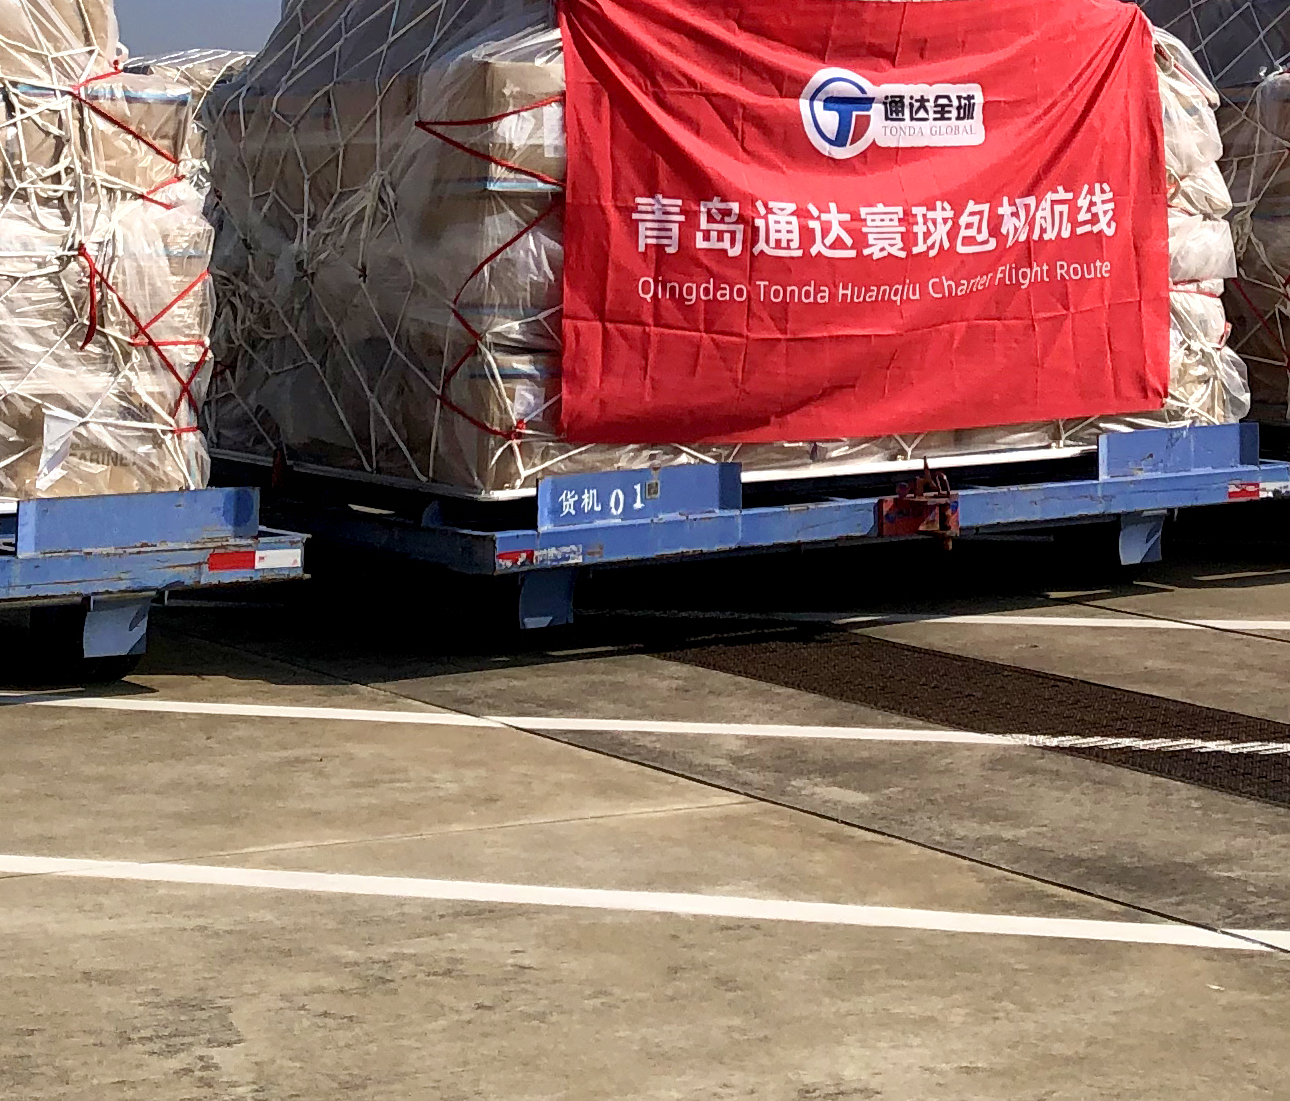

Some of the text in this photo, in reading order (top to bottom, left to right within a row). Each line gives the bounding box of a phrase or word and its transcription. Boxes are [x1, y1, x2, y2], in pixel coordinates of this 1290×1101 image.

[883, 94, 976, 121] 通达全球
[882, 124, 976, 137] TONDA GLOBAL
[632, 183, 1117, 261] 青岛通达寰球包机航线
[638, 259, 1111, 306] Qingdao Tonda Huanqiu Charter Flight Route
[559, 482, 645, 517] 货机 01
